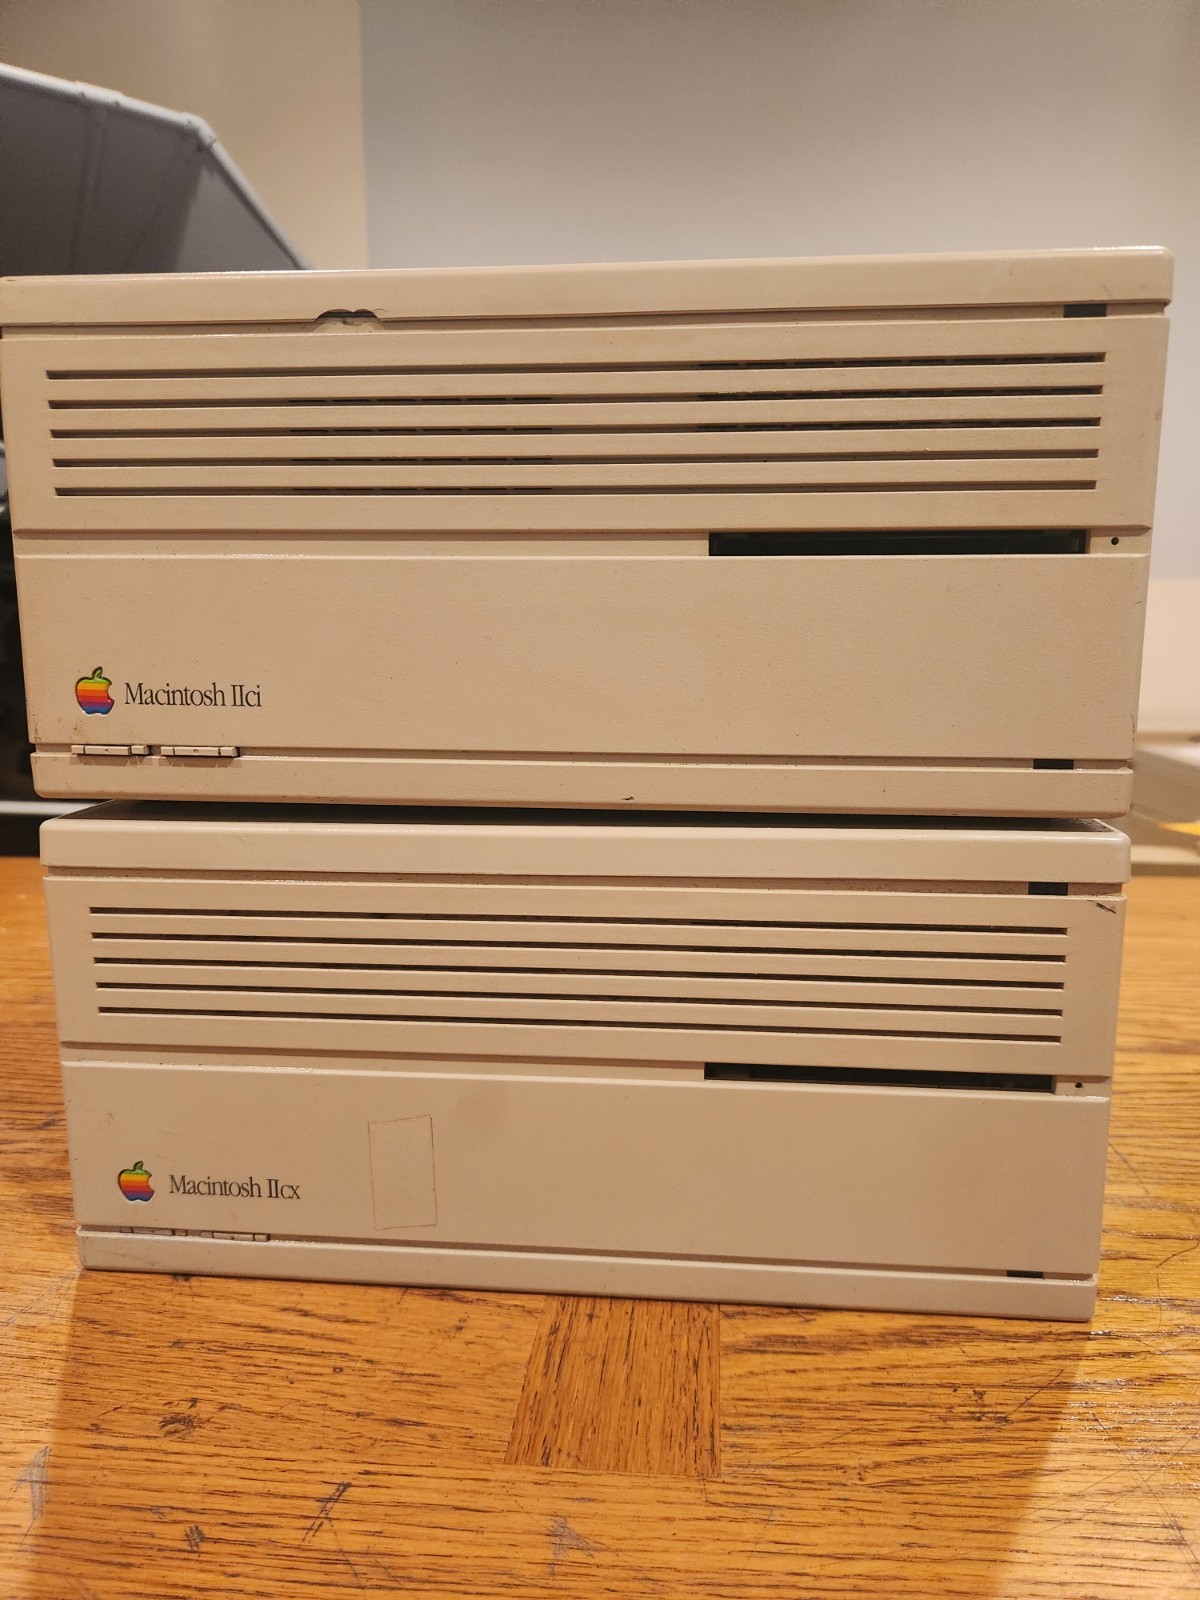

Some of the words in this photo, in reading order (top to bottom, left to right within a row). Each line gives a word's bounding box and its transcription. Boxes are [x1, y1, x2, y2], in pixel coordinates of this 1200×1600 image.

[124, 682, 227, 707] Macintosh
[231, 684, 263, 708] IIci
[168, 1174, 261, 1198] Macintosh
[266, 1178, 301, 1199] IIcx
